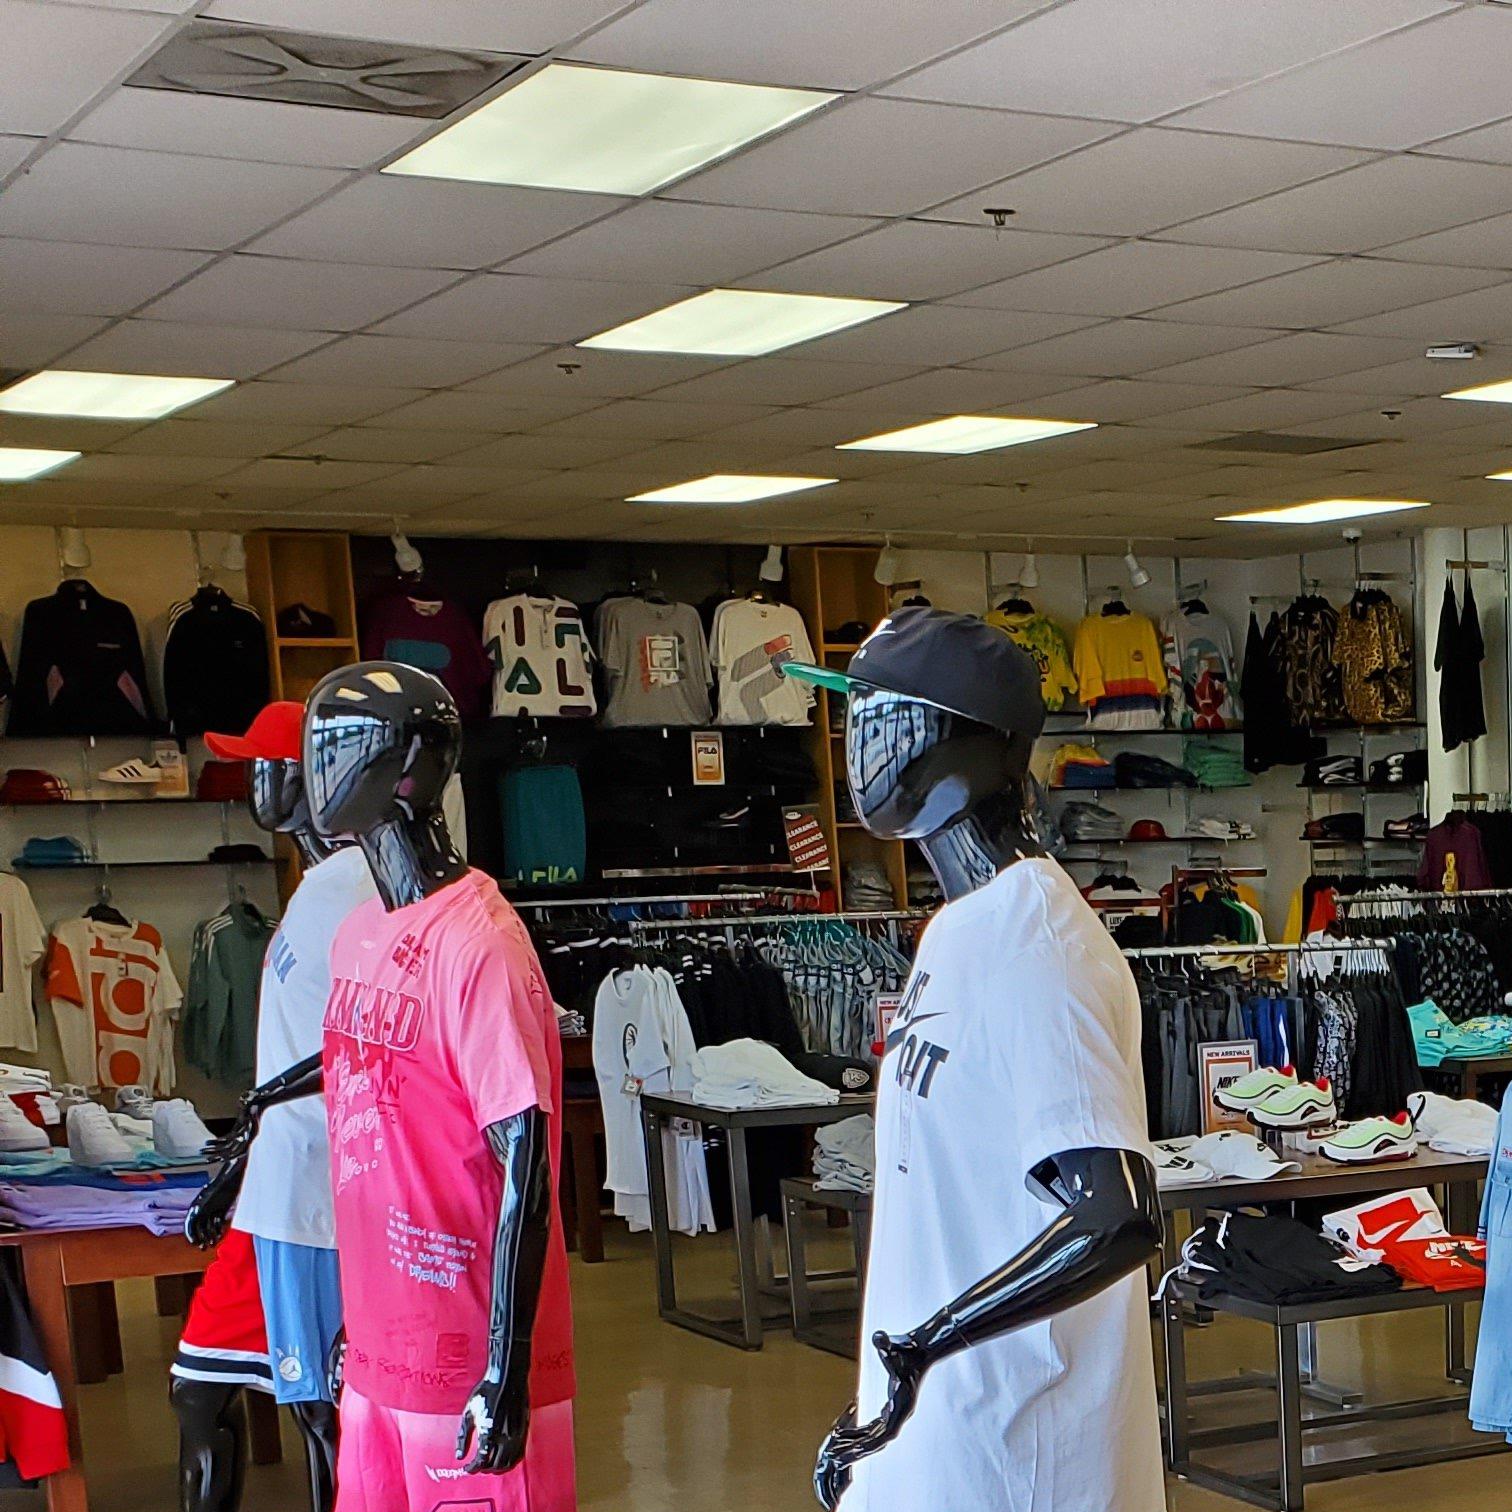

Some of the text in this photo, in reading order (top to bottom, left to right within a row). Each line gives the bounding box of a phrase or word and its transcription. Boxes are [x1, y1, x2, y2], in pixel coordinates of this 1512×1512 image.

[697, 746, 718, 755] FILA
[531, 865, 578, 884] FILA
[1221, 1049, 1250, 1058] ARRIVALS
